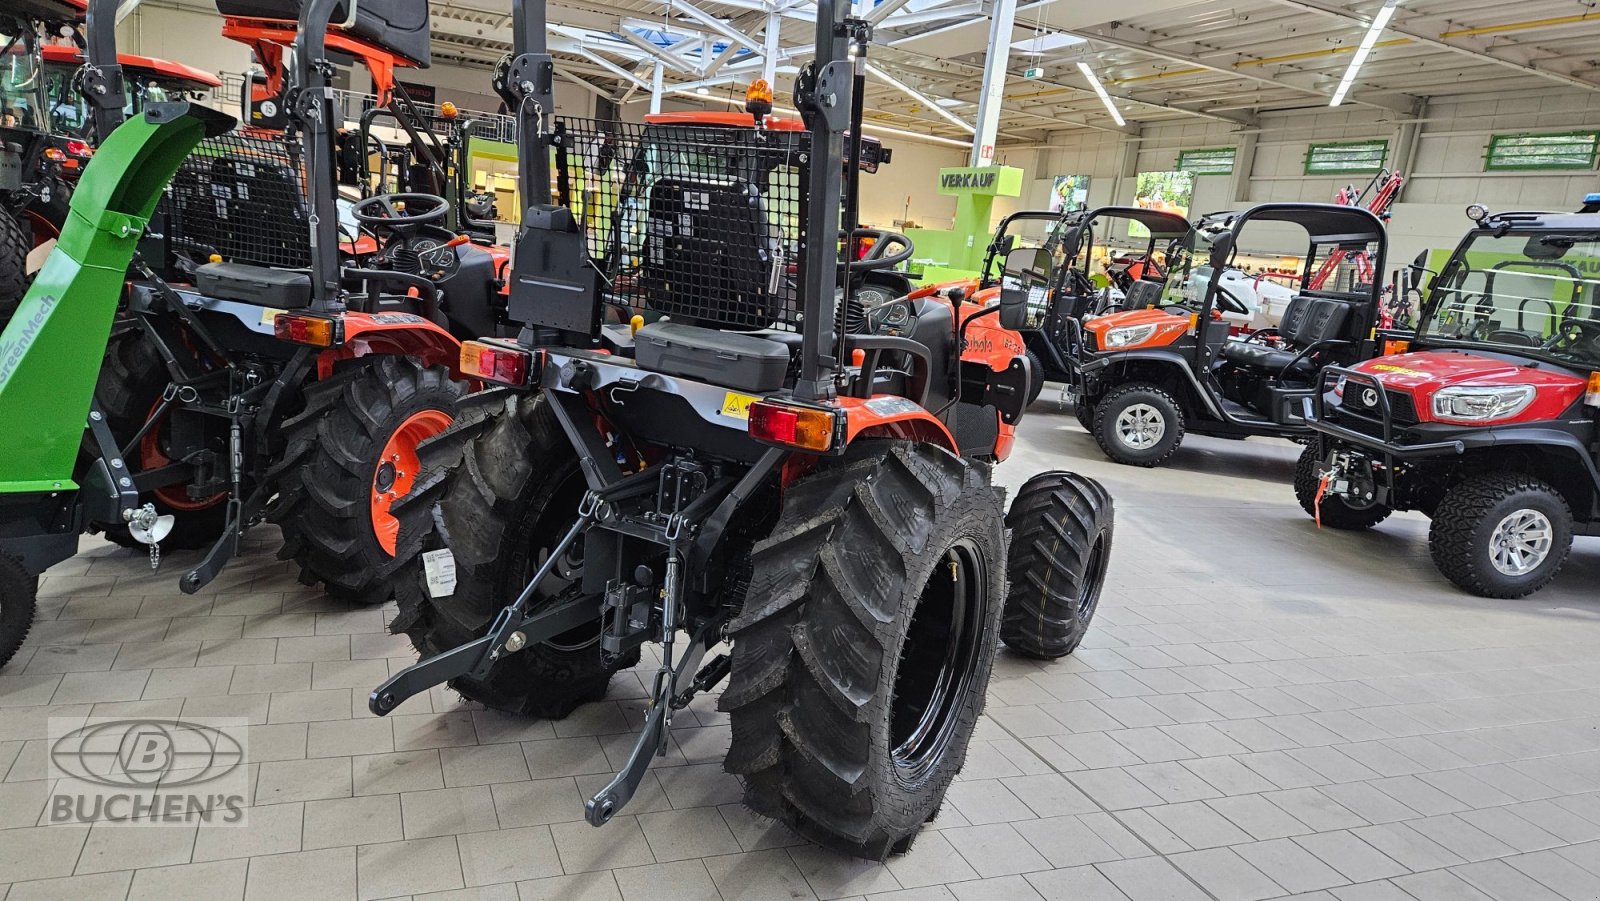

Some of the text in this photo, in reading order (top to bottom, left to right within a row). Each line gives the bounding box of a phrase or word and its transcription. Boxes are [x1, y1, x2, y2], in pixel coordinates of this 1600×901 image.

[265, 104, 273, 114] 15
[941, 173, 996, 188] VERKAUF
[0, 294, 55, 385] GreenMech
[966, 335, 993, 352] ubota
